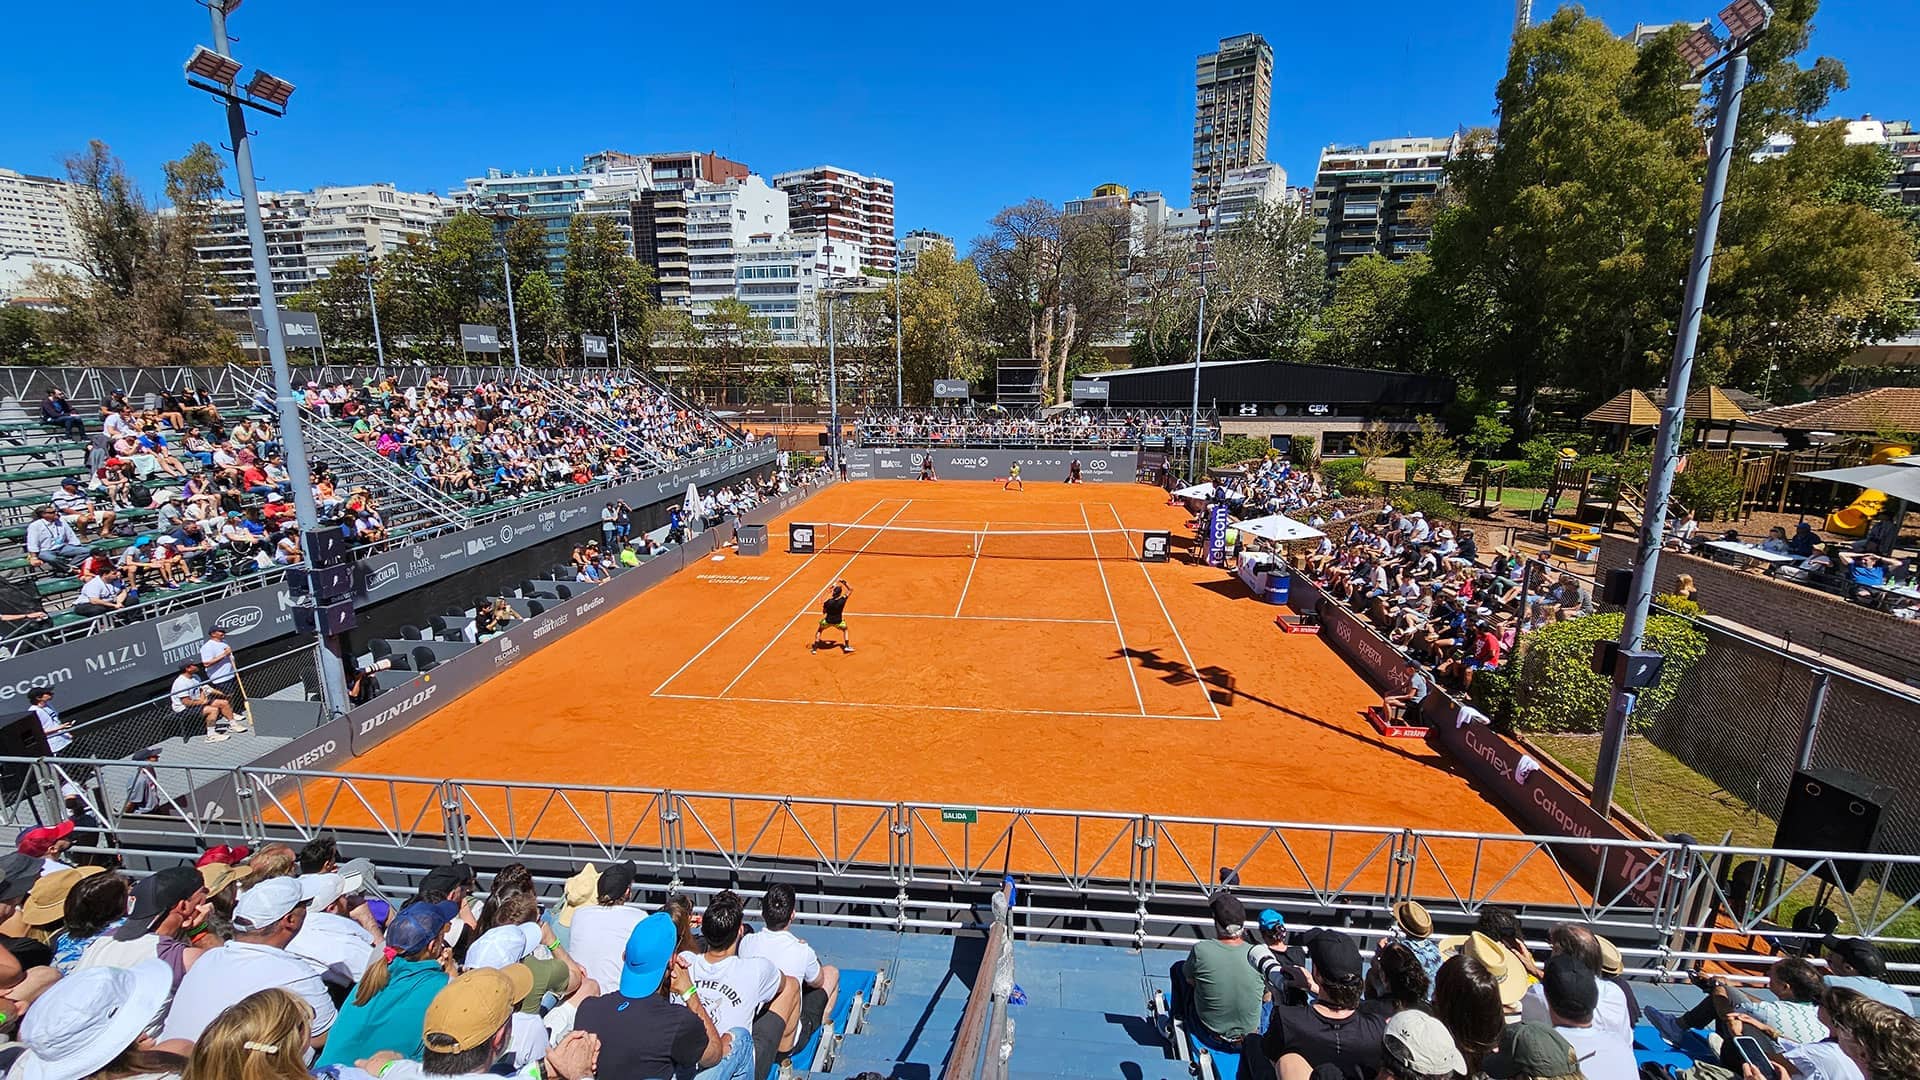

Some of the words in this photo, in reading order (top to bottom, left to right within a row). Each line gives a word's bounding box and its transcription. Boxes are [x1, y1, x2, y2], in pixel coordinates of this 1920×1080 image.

[586, 339, 606, 353] FILA
[951, 457, 977, 465] AXION
[405, 563, 437, 579] RECOVERY
[409, 557, 431, 570] HAIR
[218, 611, 261, 629] Tregar
[532, 613, 569, 640] smartwater
[85, 640, 147, 674] MIZU
[1358, 639, 1382, 666] EXPERTA
[359, 684, 437, 736] DUNLOP
[1465, 728, 1513, 782] Curflex
[943, 812, 967, 820] SALIDA
[694, 980, 719, 990] THE
[719, 984, 742, 1007] RIDE
